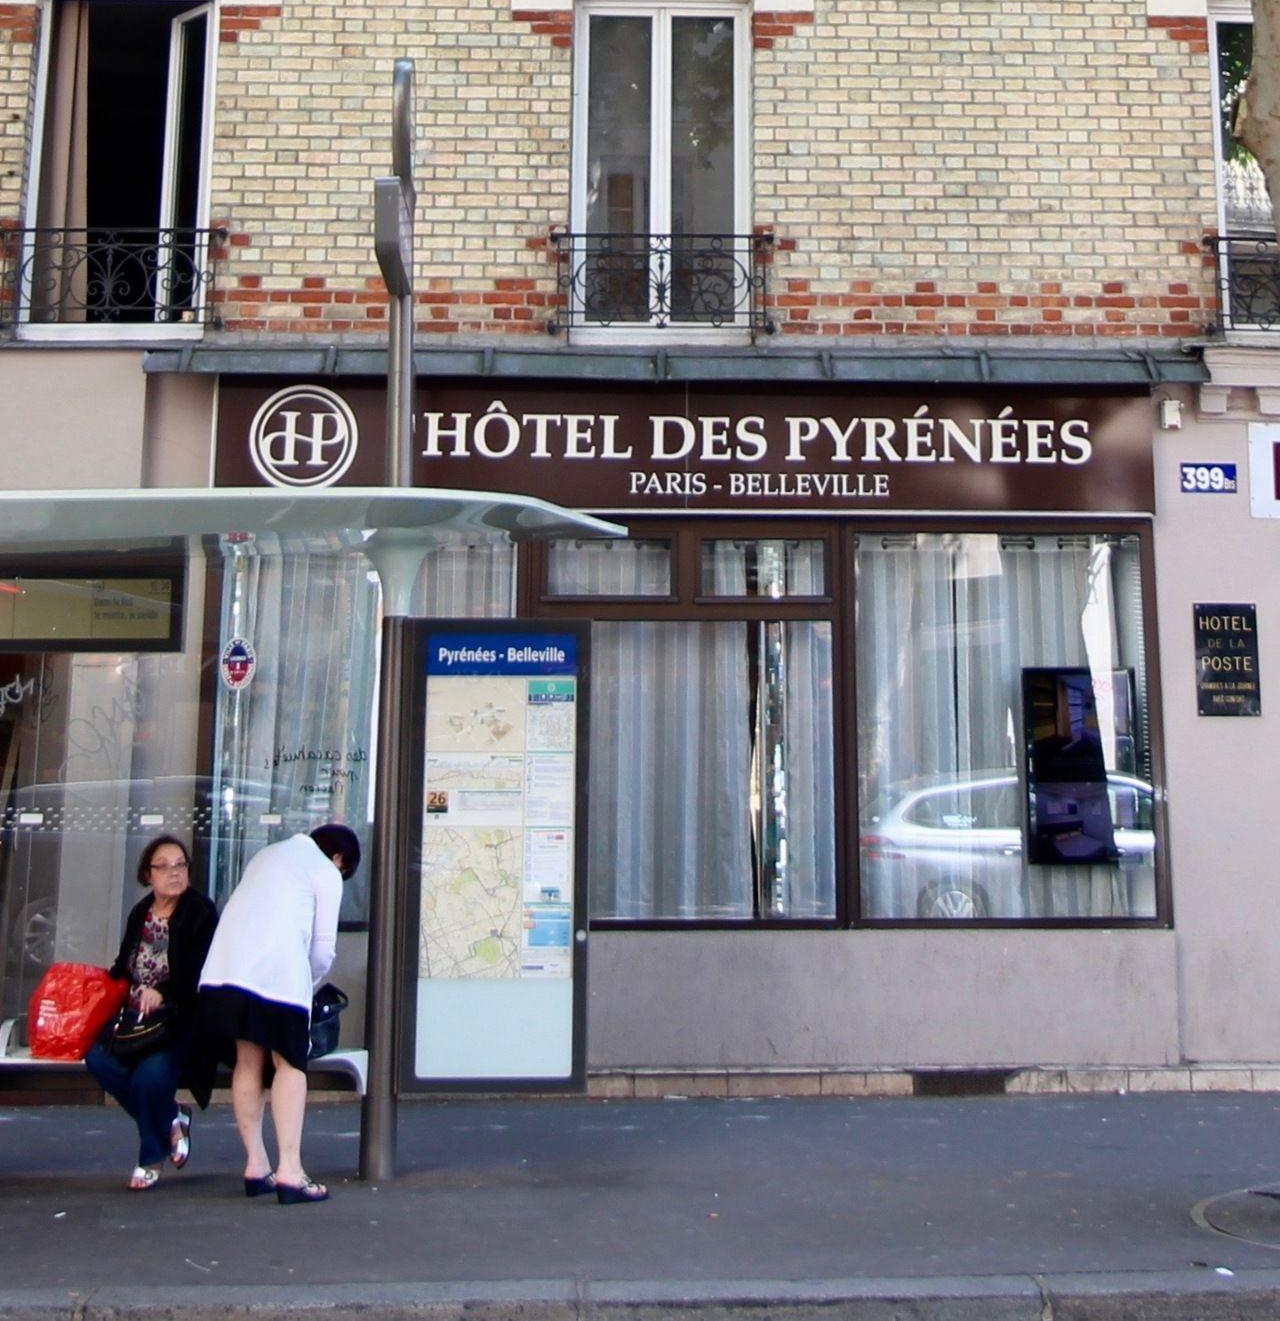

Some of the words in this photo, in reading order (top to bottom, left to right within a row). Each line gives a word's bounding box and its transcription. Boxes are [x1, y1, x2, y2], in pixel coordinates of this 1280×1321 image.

[422, 400, 632, 458] HÔTEL
[649, 415, 768, 462] DES
[784, 405, 1093, 465] PYRÉNÉES
[629, 472, 707, 495] PARIS
[729, 473, 890, 496] BELLEVILLE
[1181, 466, 1224, 491] 399
[1199, 615, 1252, 631] HOTEL
[1207, 637, 1222, 649] DE
[1229, 637, 1245, 649] LA
[438, 646, 496, 666] Pyrénées
[507, 646, 565, 662] Belleville
[1201, 656, 1253, 672] POSTE
[429, 791, 446, 805] 26
